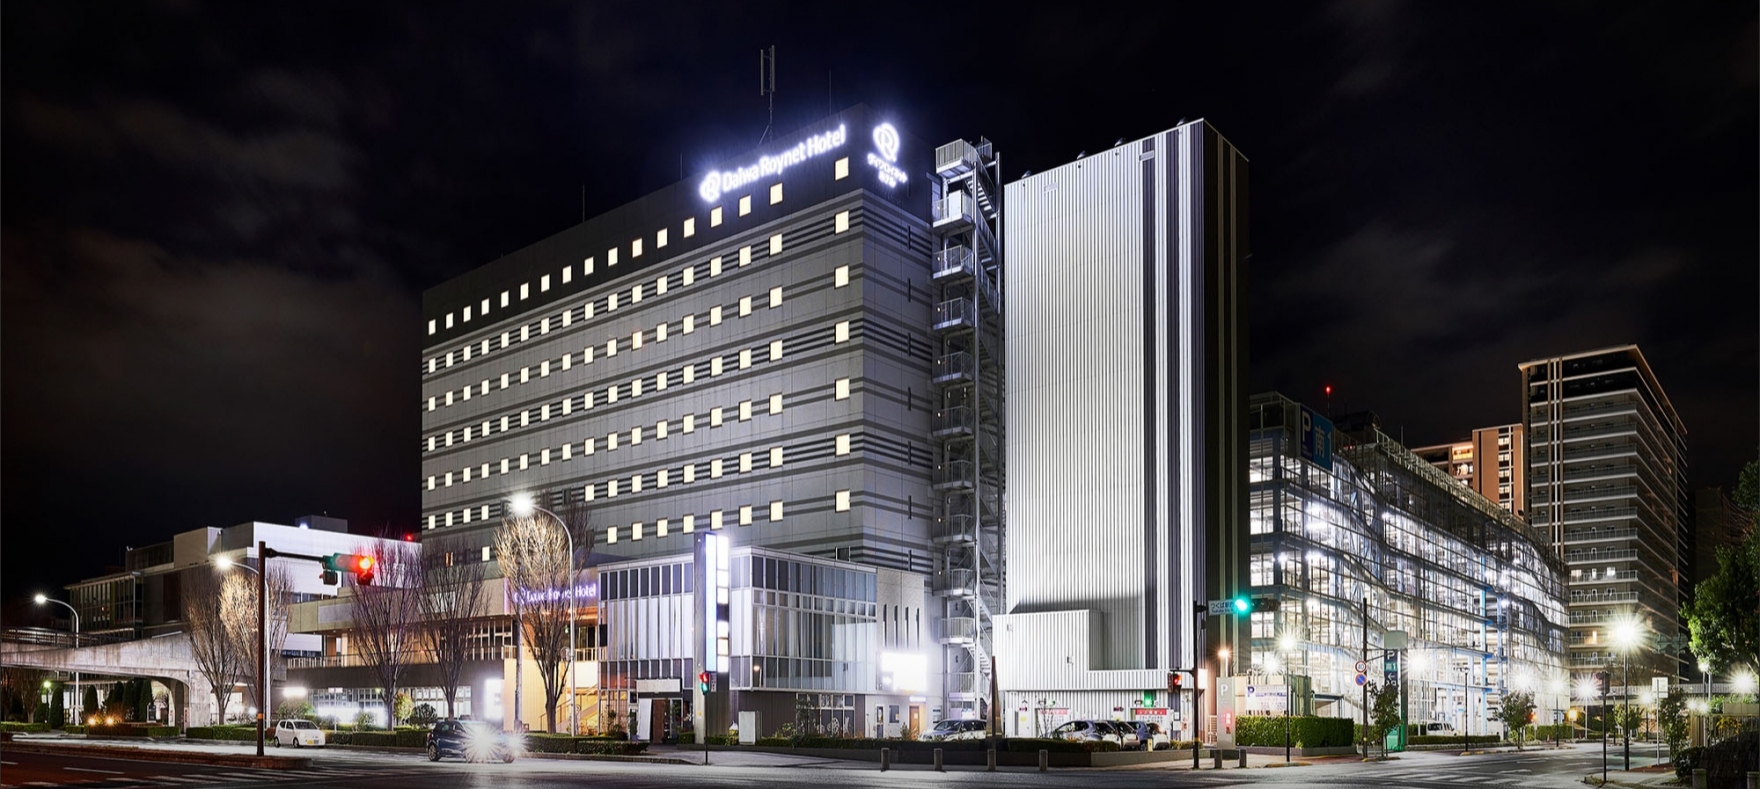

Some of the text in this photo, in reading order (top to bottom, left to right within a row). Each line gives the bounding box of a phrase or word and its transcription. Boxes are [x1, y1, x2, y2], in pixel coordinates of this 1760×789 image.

[722, 167, 759, 192] Daiwa
[759, 142, 806, 175] Roynet
[807, 123, 846, 158] Hotel
[1302, 410, 1312, 443] P
[1315, 425, 1332, 463] 南1
[575, 584, 596, 598] Hotel
[1387, 651, 1395, 660] P
[1220, 684, 1228, 696] P
[1247, 685, 1255, 698] P
